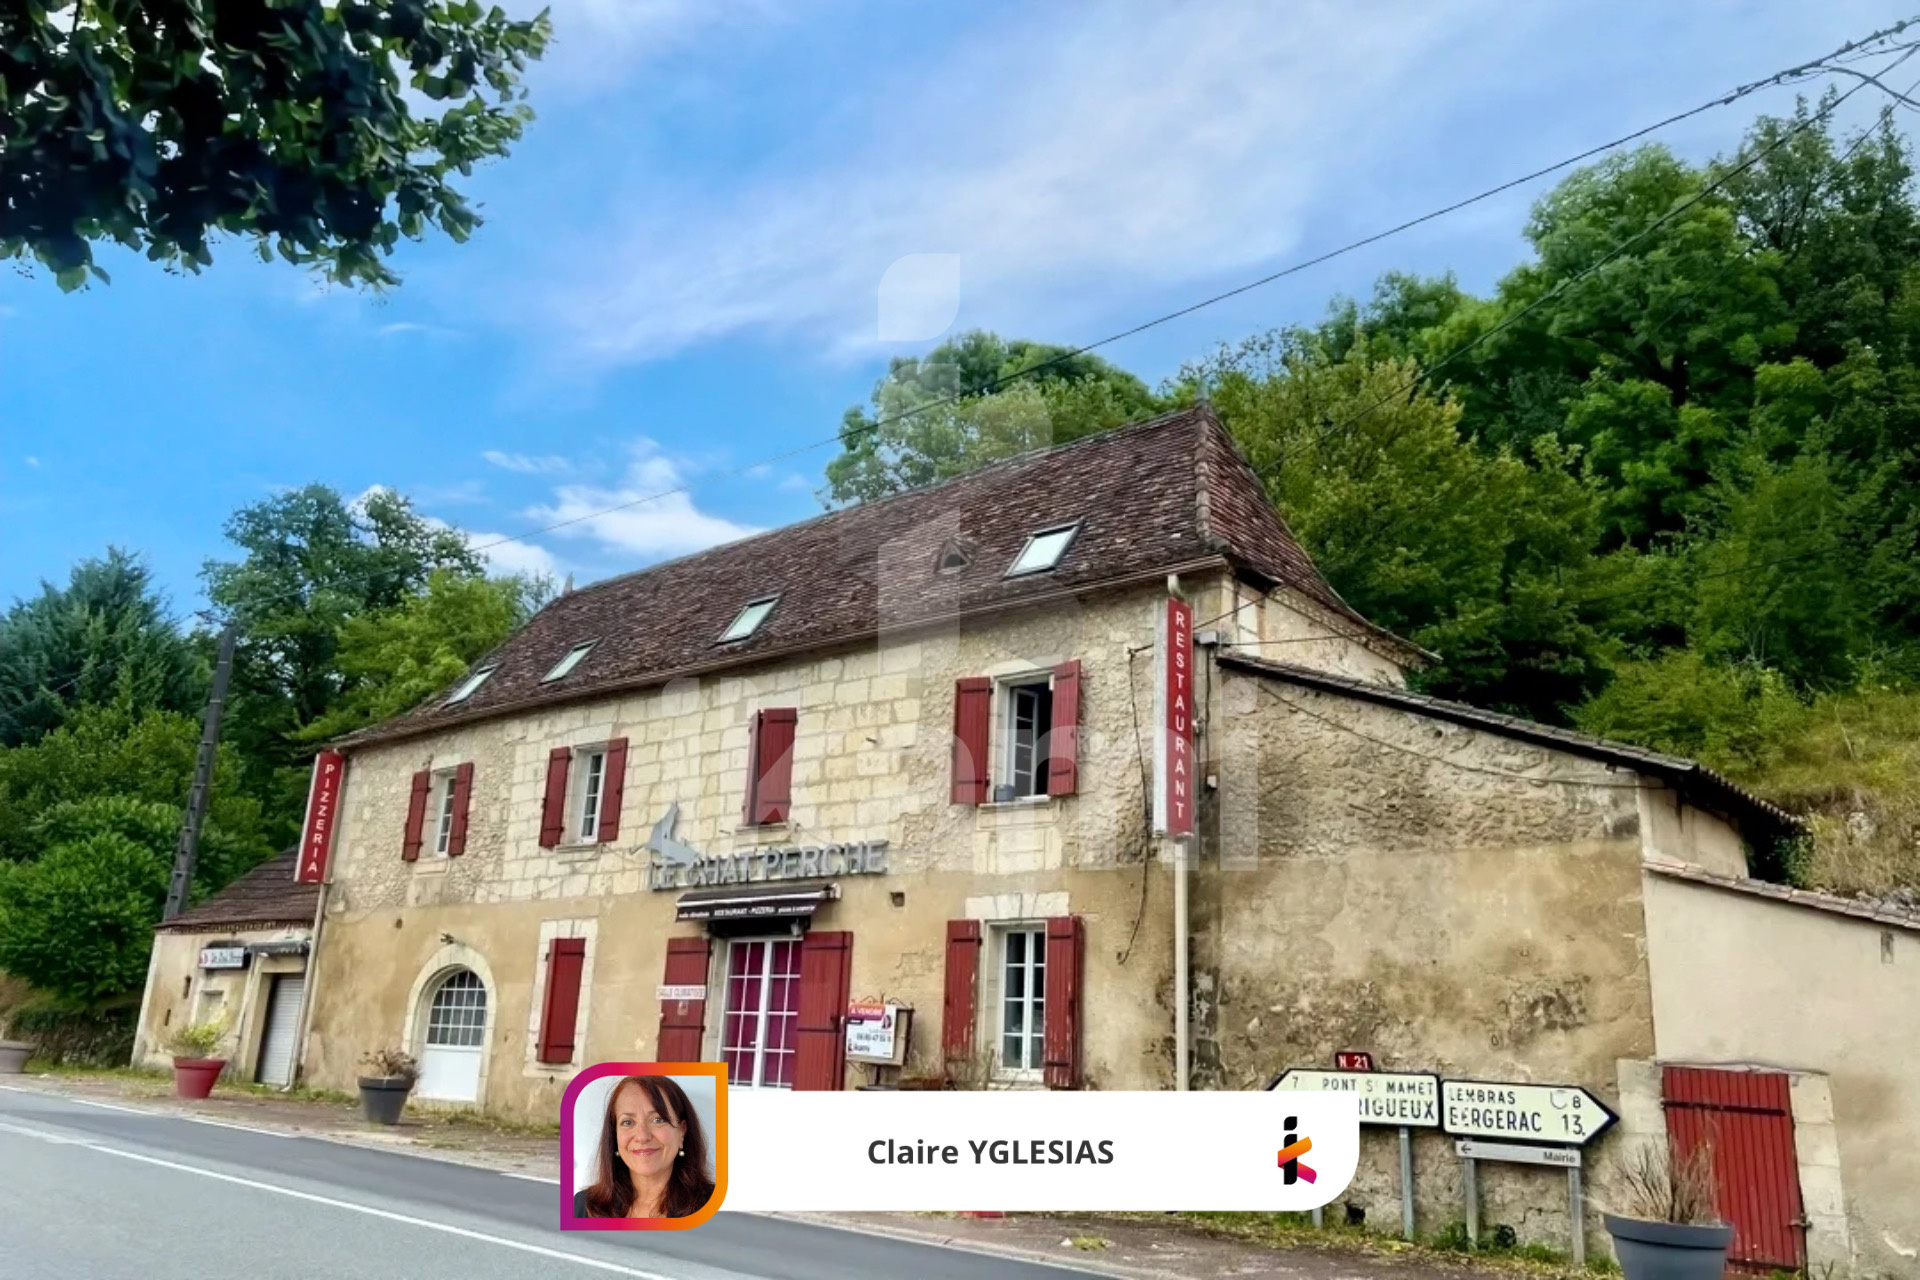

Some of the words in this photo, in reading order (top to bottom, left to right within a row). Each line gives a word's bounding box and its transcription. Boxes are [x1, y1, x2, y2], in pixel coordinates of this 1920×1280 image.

[1175, 610, 1185, 819] RESTAURANT
[307, 763, 335, 873] PIZZERIA
[684, 853, 751, 887] CHAT
[1338, 1055, 1346, 1067] N
[1354, 1055, 1368, 1069] 21
[1292, 1076, 1299, 1089] 7
[1322, 1078, 1357, 1091] PONT
[1386, 1082, 1434, 1095] MAMET
[1572, 1095, 1581, 1109] 8
[1543, 1152, 1576, 1164] Mairie
